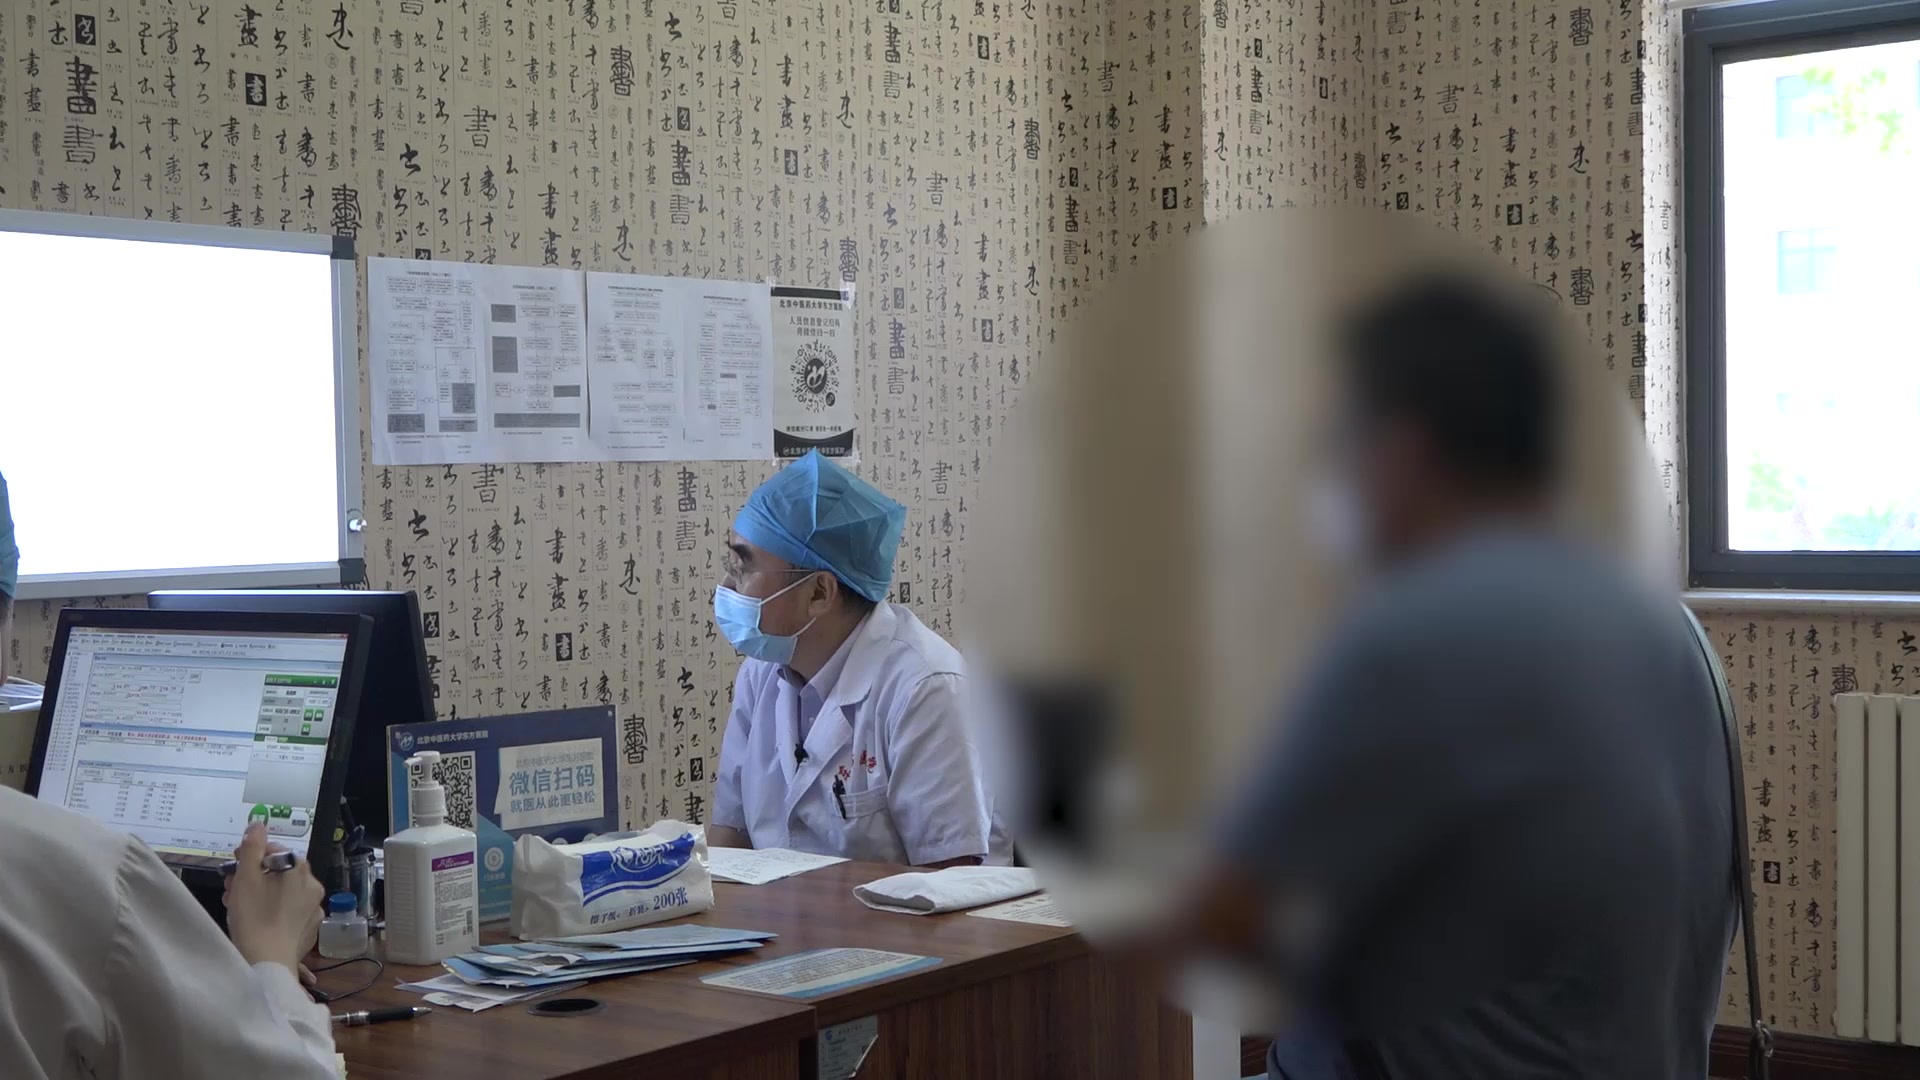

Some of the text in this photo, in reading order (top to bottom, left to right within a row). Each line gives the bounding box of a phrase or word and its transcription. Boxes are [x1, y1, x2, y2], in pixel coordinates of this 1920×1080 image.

[416, 729, 488, 745] 北京中医药大学东方医院
[509, 764, 595, 796] 微信扫码
[510, 790, 595, 813] 就医从此更轻松
[653, 887, 689, 911] 200张
